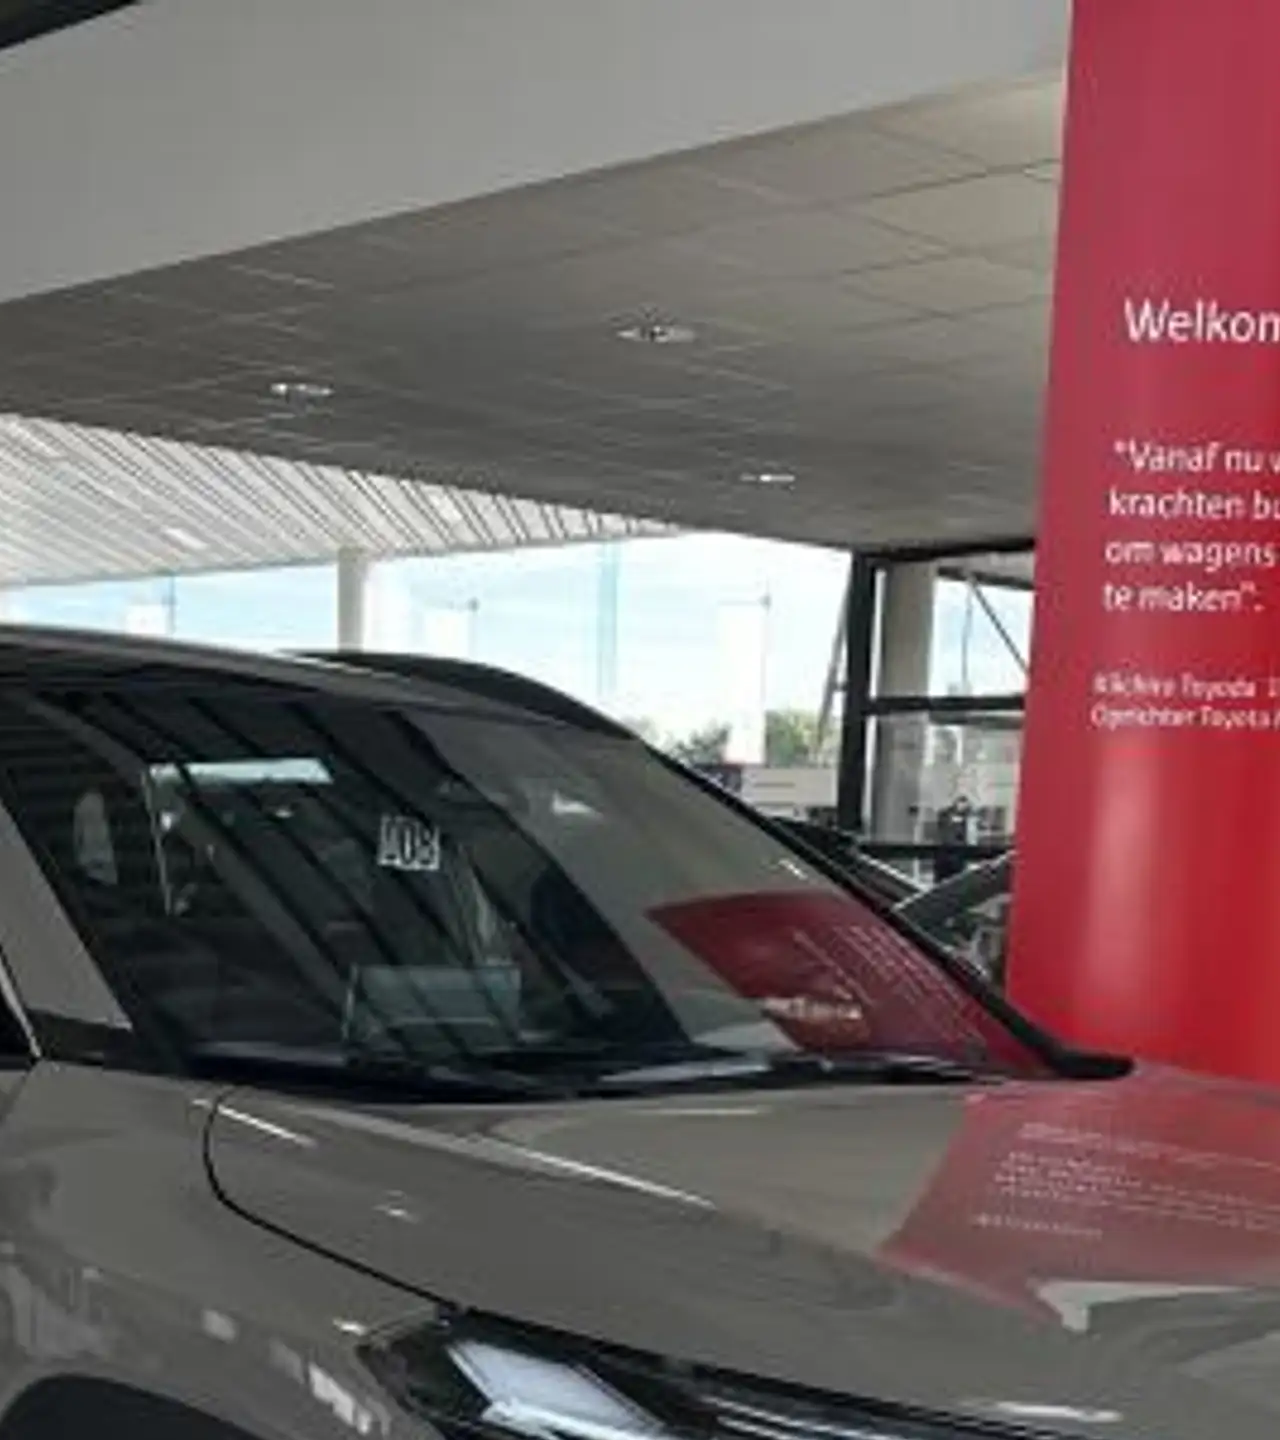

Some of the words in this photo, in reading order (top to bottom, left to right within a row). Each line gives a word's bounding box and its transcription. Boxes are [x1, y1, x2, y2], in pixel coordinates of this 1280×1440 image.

[1224, 449, 1265, 473] nu
[1108, 485, 1246, 519] krachten
[1103, 541, 1155, 565] om
[1159, 541, 1277, 573] wagens
[1103, 581, 1131, 612] te
[1199, 704, 1271, 732] Toyota
